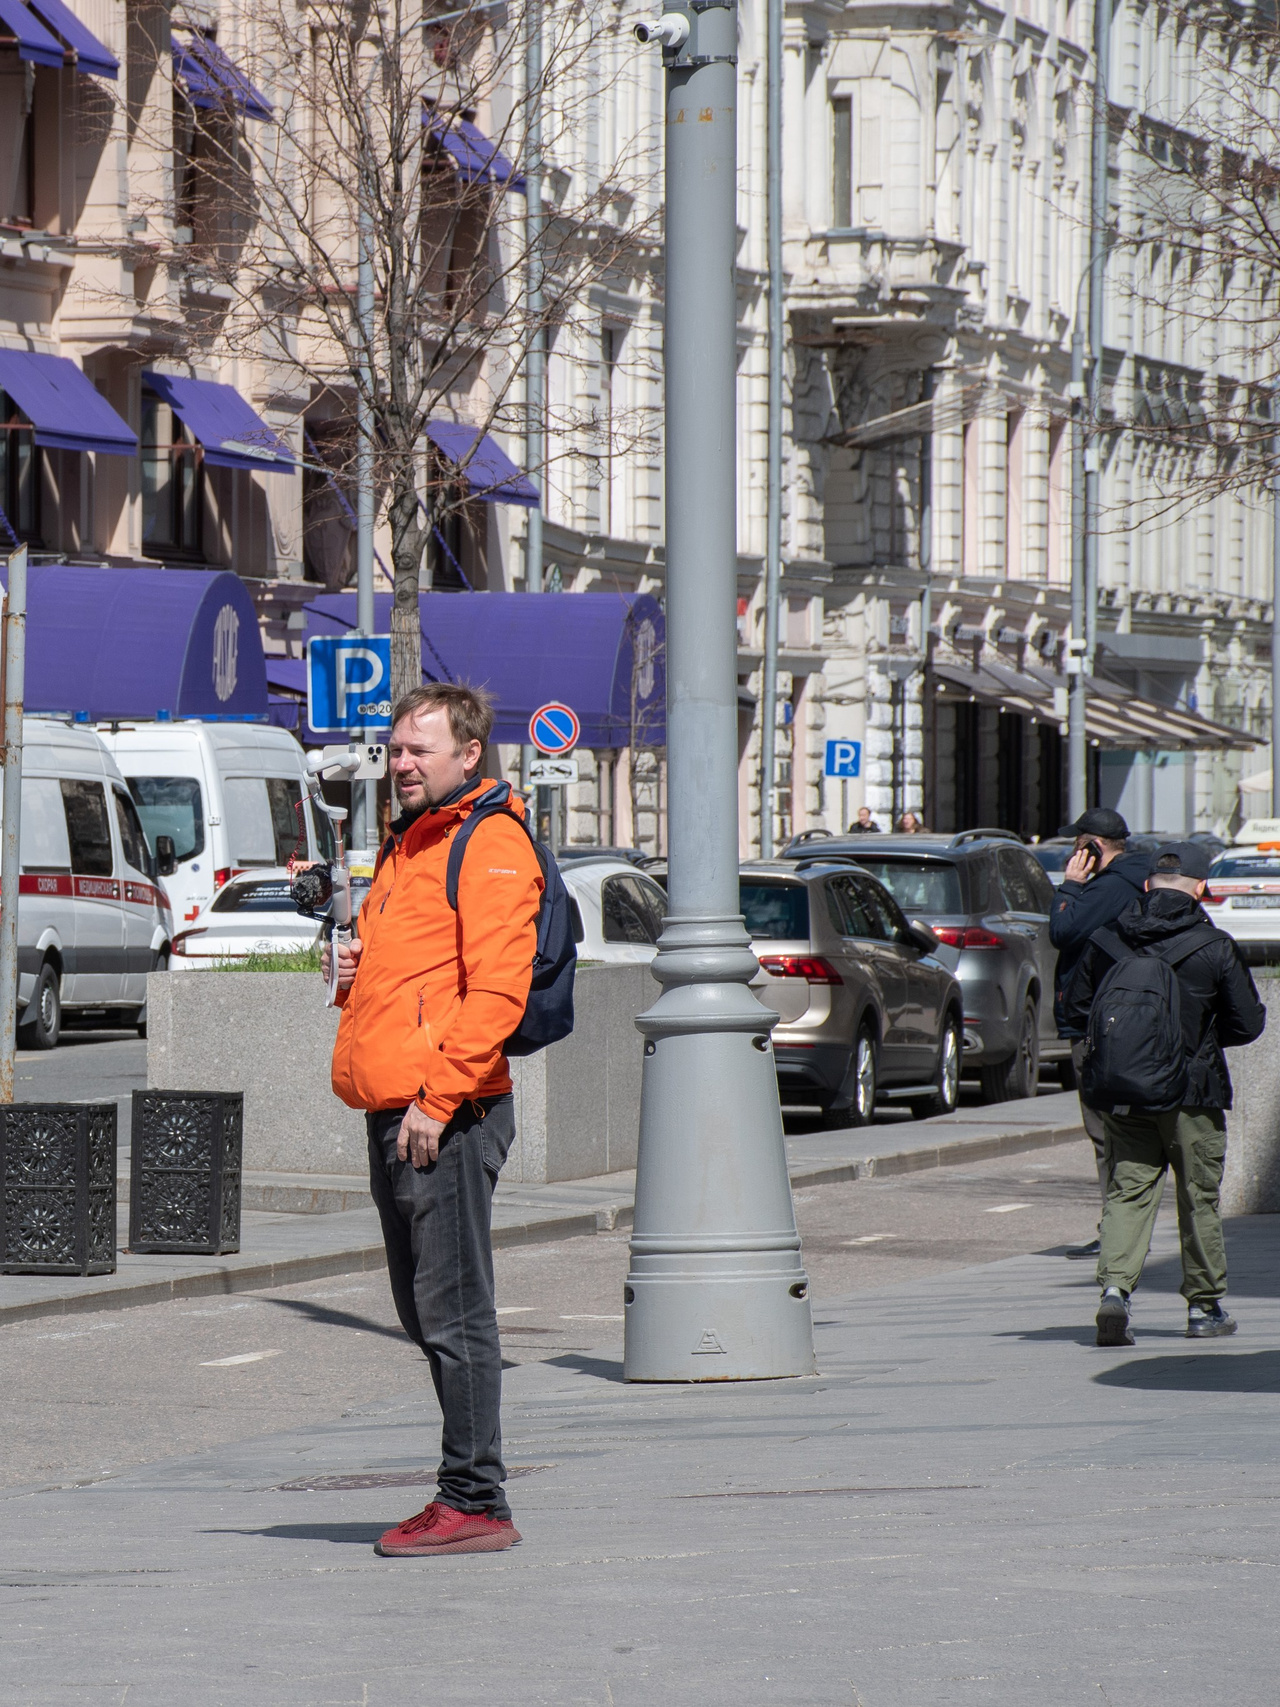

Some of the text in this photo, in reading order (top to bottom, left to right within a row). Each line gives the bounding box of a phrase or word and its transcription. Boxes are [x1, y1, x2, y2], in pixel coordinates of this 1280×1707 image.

[336, 648, 384, 718] P
[368, 706, 376, 714] 15
[379, 704, 392, 714] 20
[834, 743, 856, 774] P
[37, 878, 58, 892] СКОРАЯ
[78, 880, 113, 896] МЕДИЦИНСКАЯ
